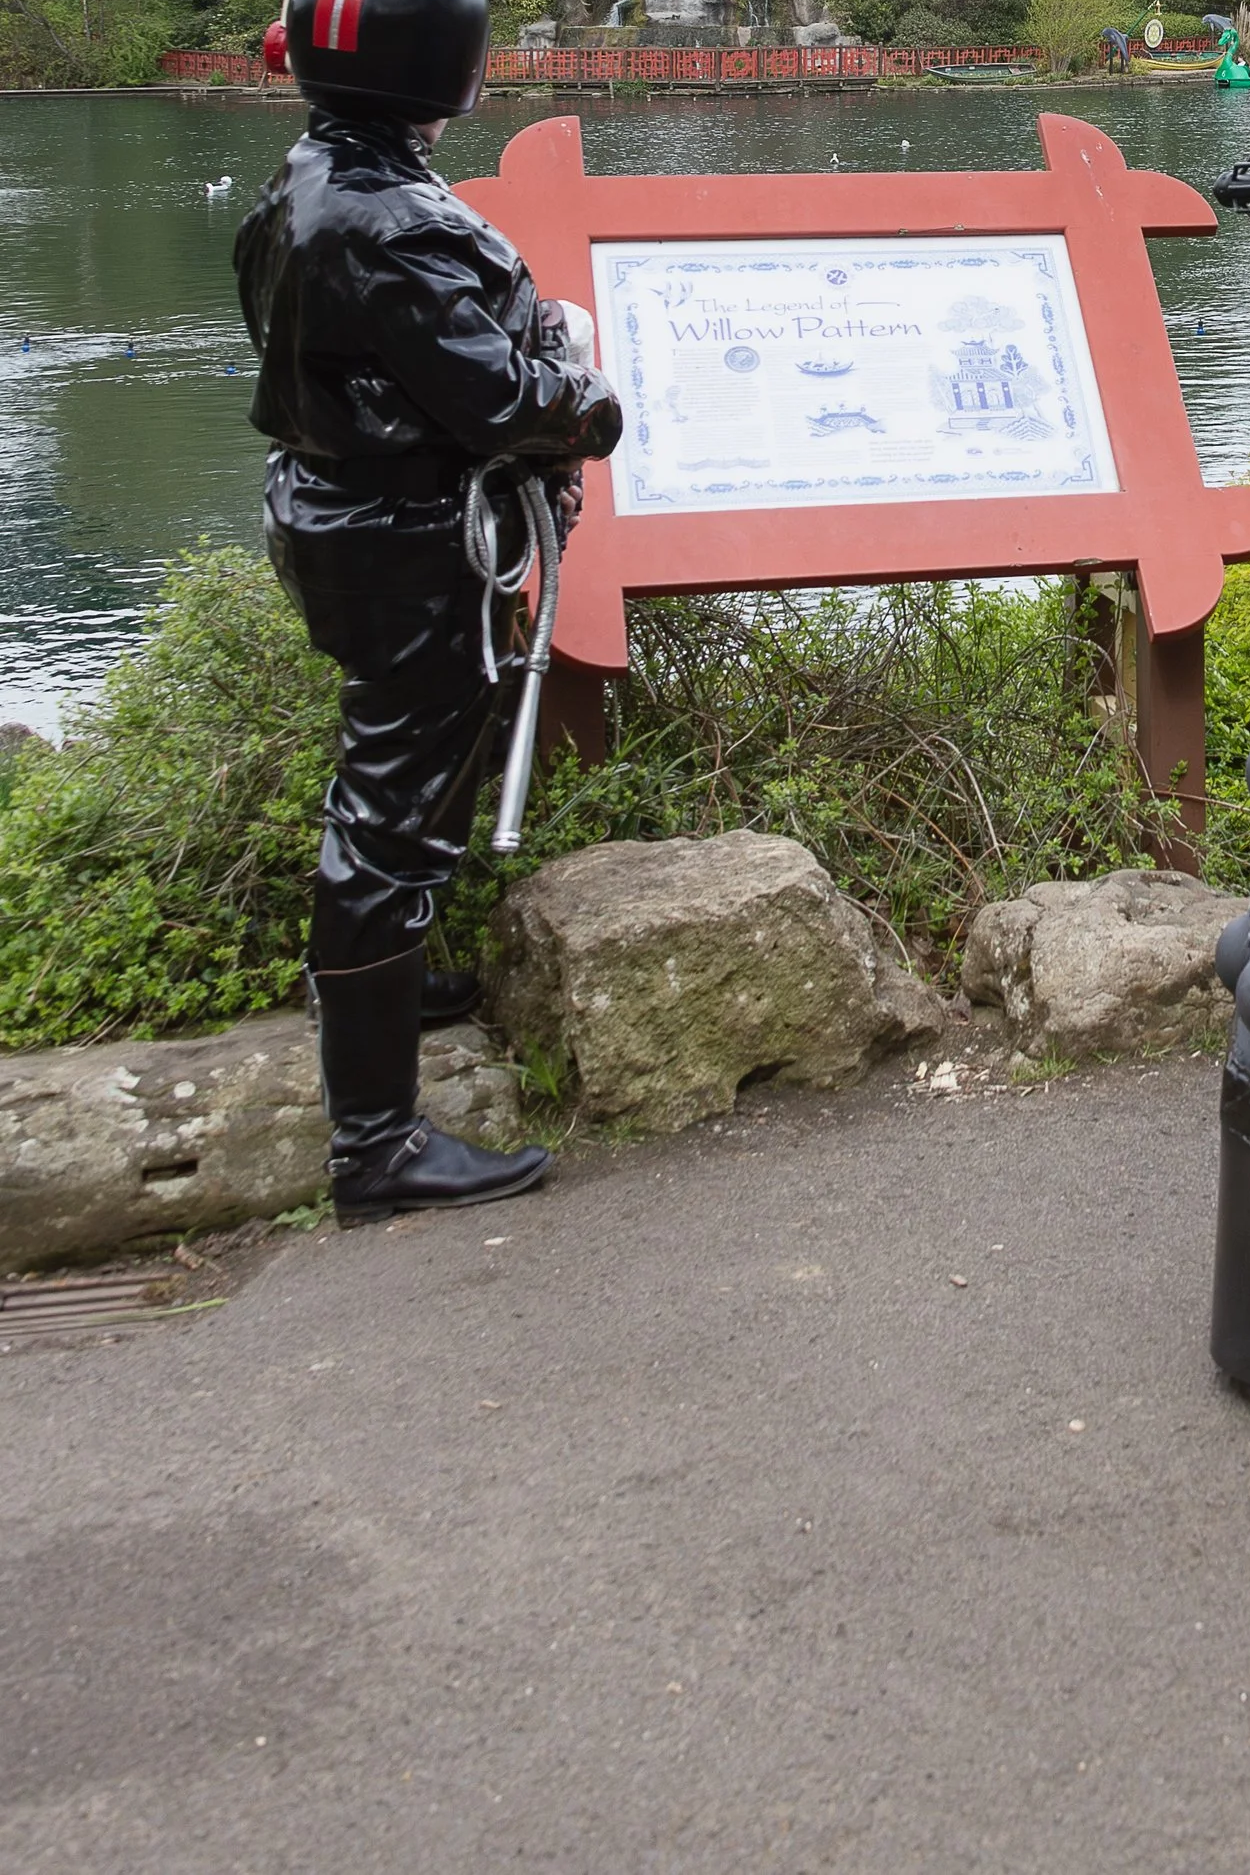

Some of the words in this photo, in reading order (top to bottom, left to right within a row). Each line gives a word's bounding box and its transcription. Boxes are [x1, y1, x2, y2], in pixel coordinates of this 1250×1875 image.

[694, 298, 738, 313] The
[745, 295, 824, 316] Legend
[829, 295, 851, 314] of
[668, 317, 785, 342] Willow
[791, 315, 923, 340] Pattern
